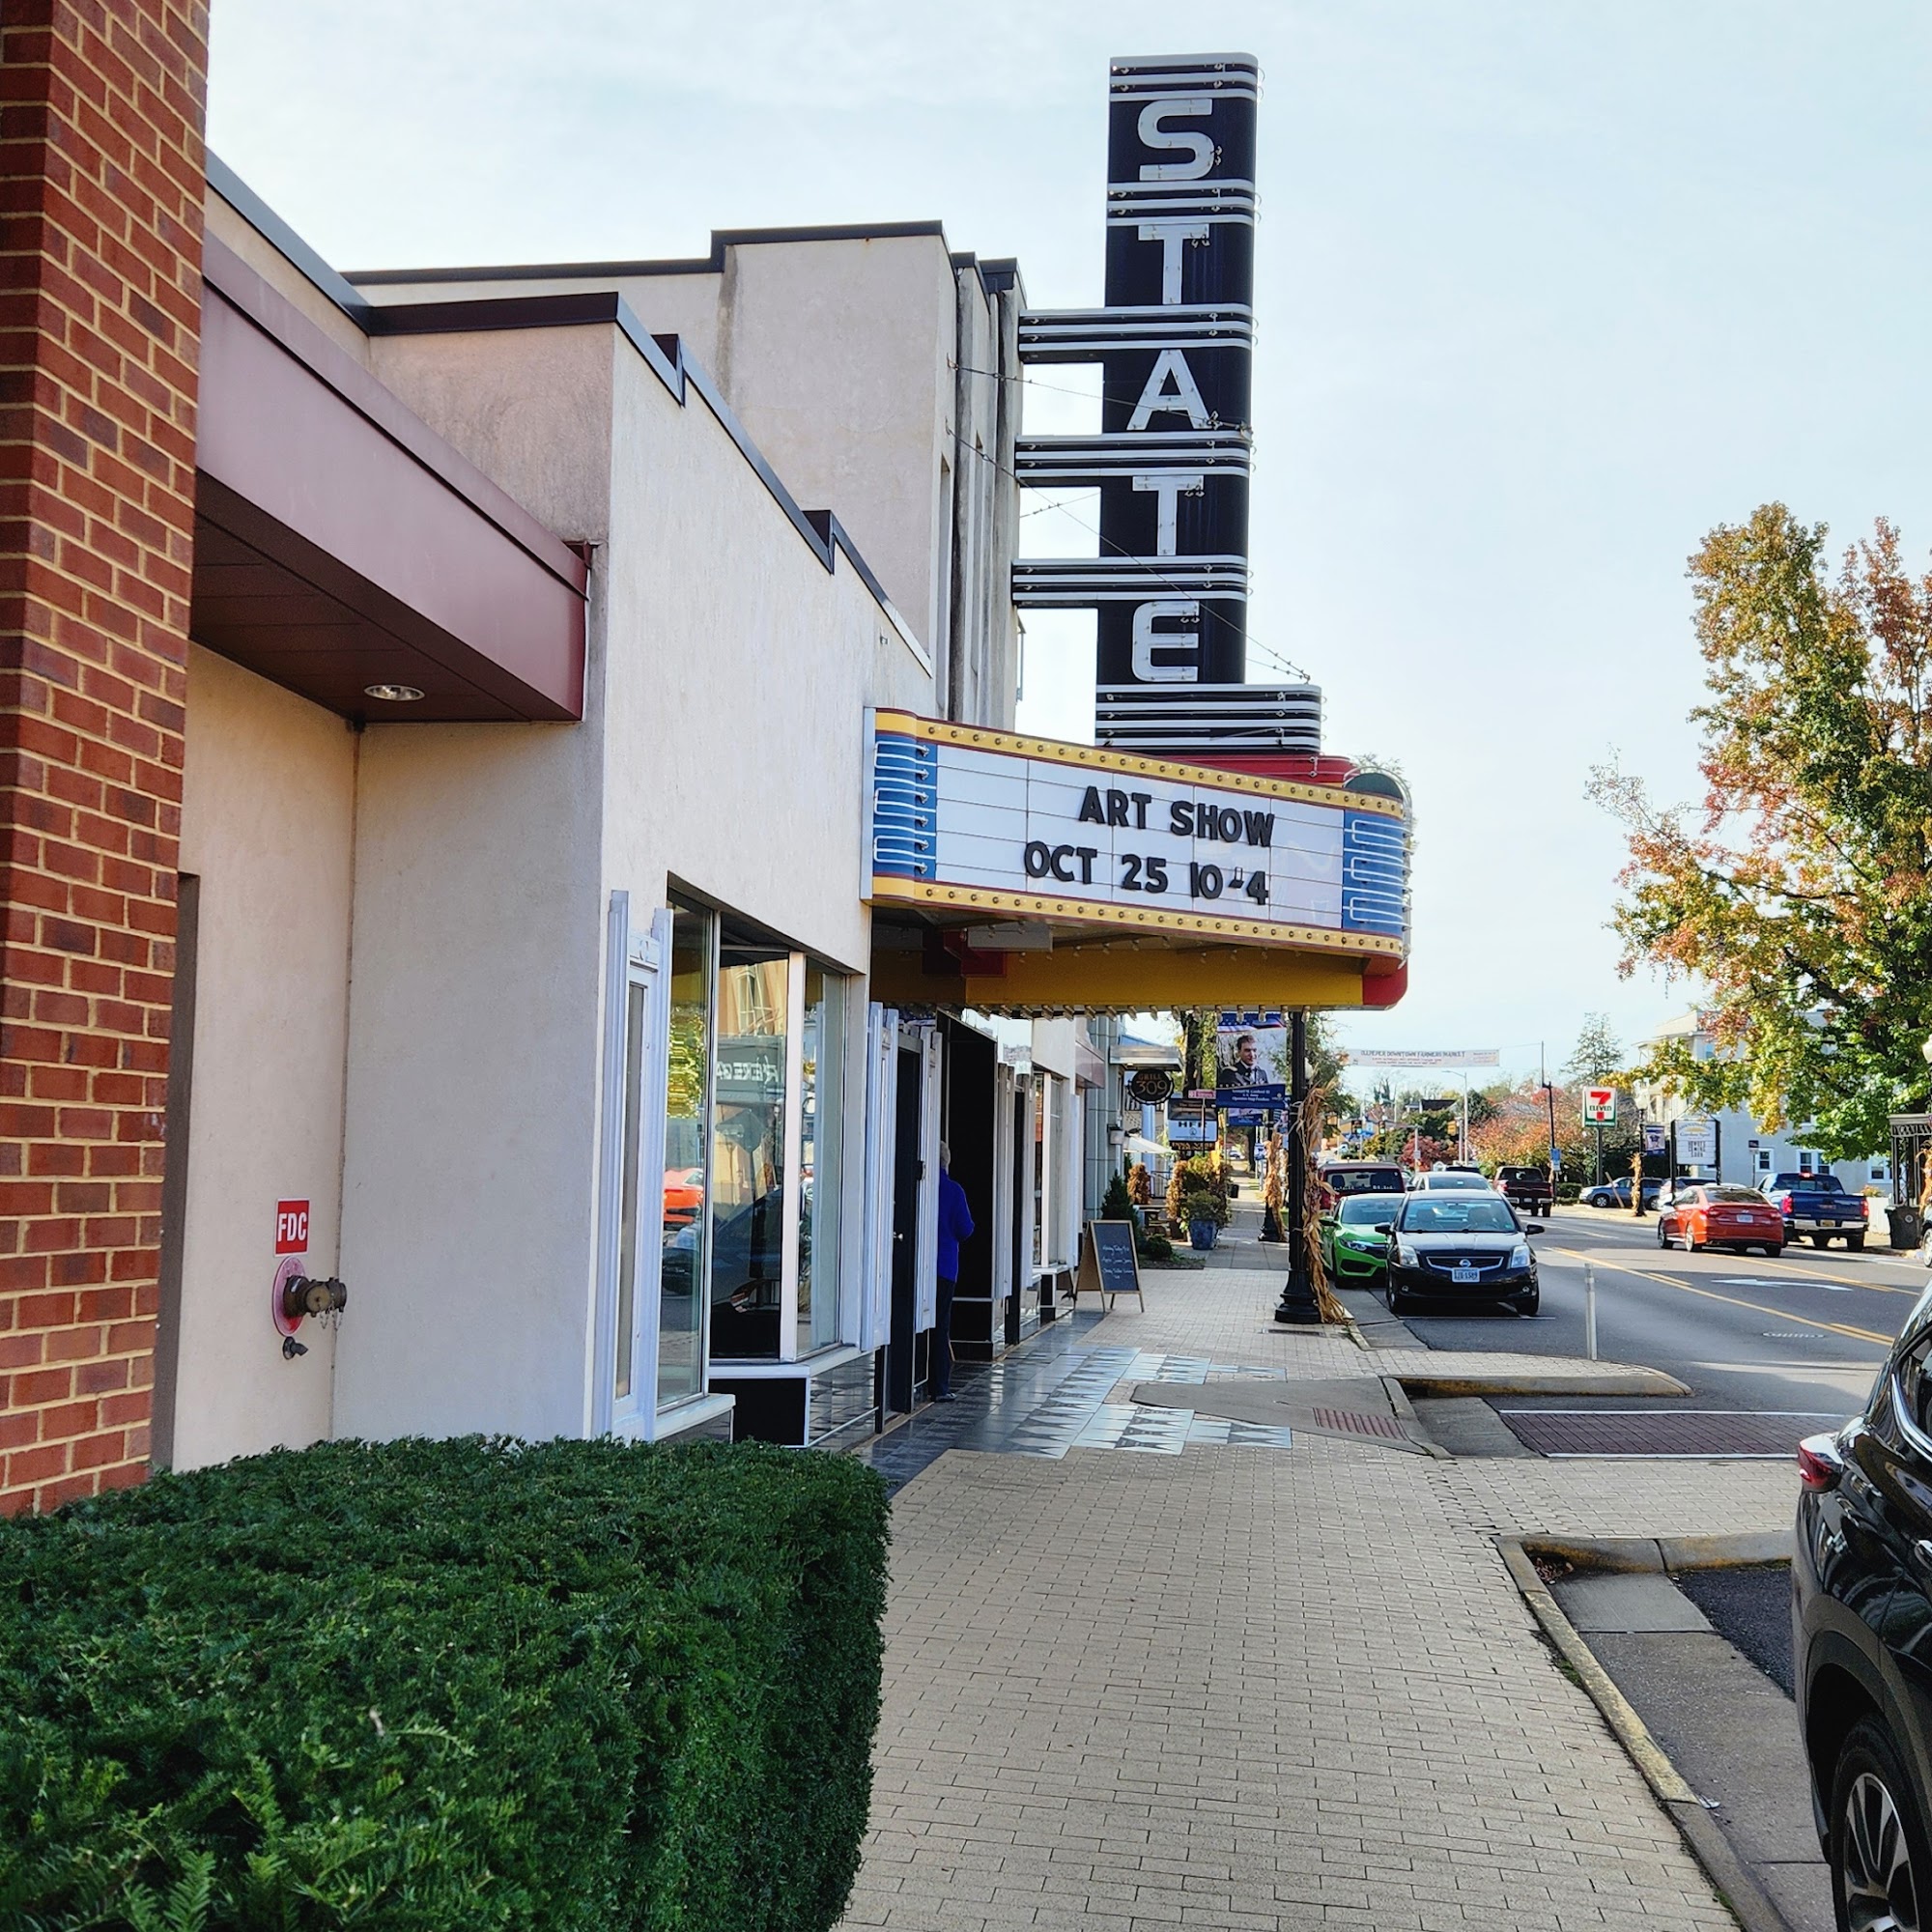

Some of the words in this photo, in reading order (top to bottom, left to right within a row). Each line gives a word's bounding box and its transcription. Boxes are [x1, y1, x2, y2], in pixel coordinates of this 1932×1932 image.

[1126, 99, 1214, 681] STATE
[1079, 786, 1151, 829] ART
[1170, 800, 1275, 847] SHOW
[1024, 840, 1097, 884] OCT
[1122, 854, 1168, 894] 25
[1136, 1081, 1168, 1095] 309
[277, 1211, 308, 1242] FDC
